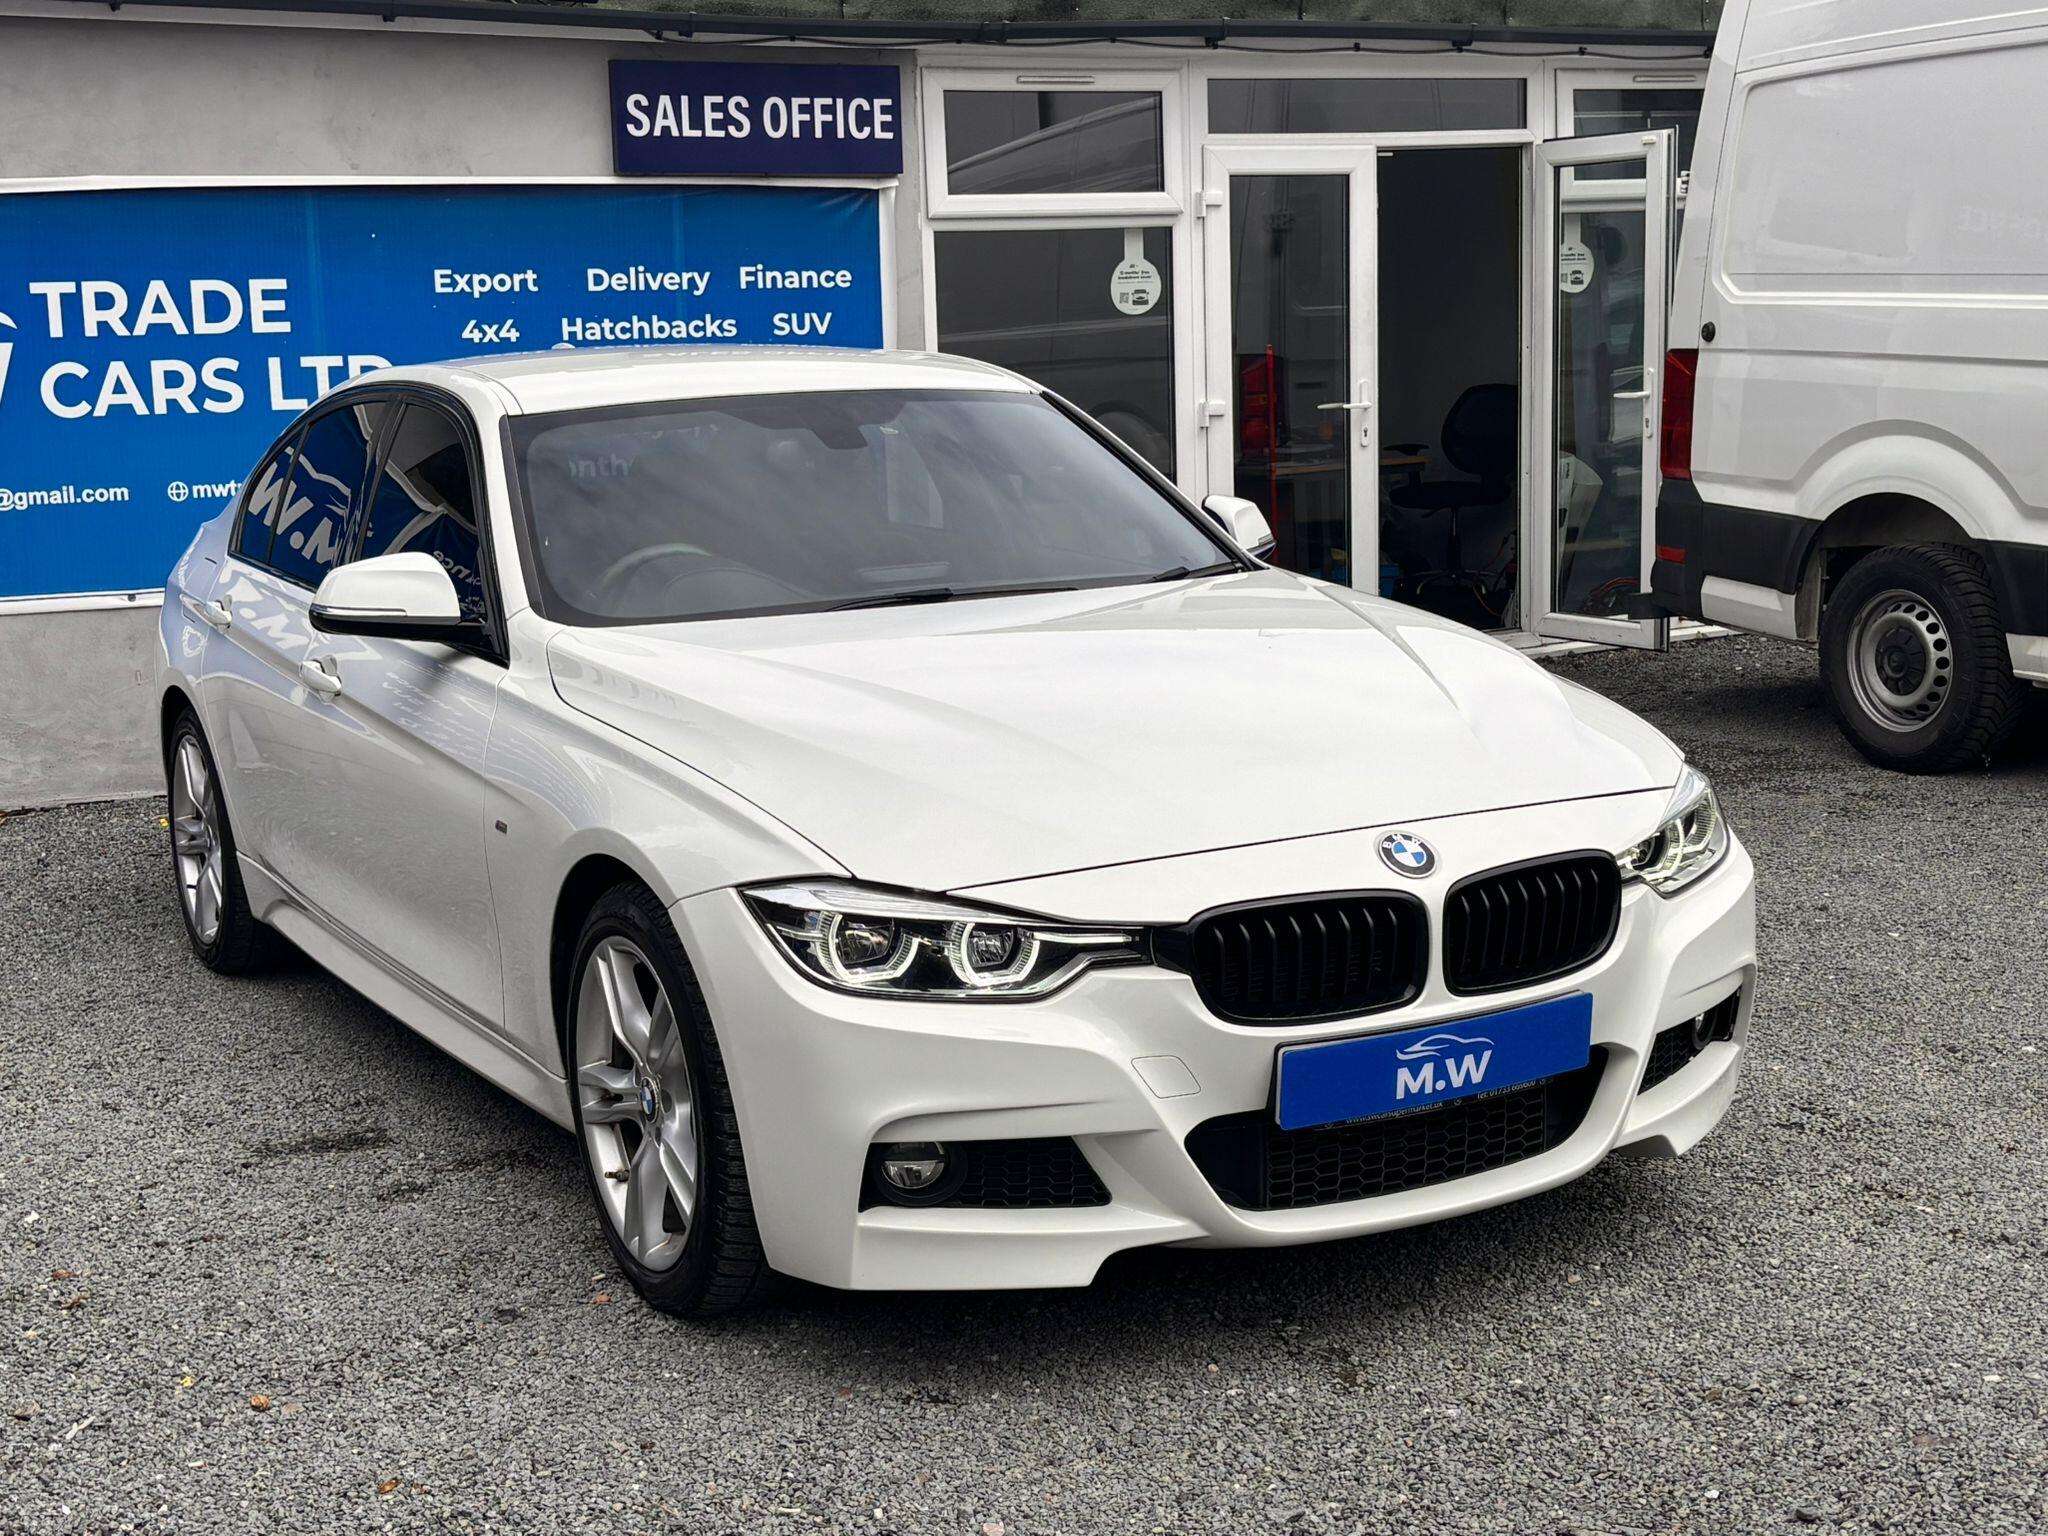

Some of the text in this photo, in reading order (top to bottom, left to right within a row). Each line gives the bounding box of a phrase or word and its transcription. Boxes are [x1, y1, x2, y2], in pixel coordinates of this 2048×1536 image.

[626, 94, 895, 140] SALES OFFICE
[433, 269, 539, 298] Export
[586, 266, 711, 296] Delivery
[739, 264, 853, 289] Finance
[29, 278, 291, 338] TRADE
[461, 319, 520, 343] 4x4
[561, 313, 738, 345] Hatchbacks
[772, 312, 832, 336] SUV
[40, 358, 245, 419] CARS
[1395, 1049, 1493, 1100] M.W
